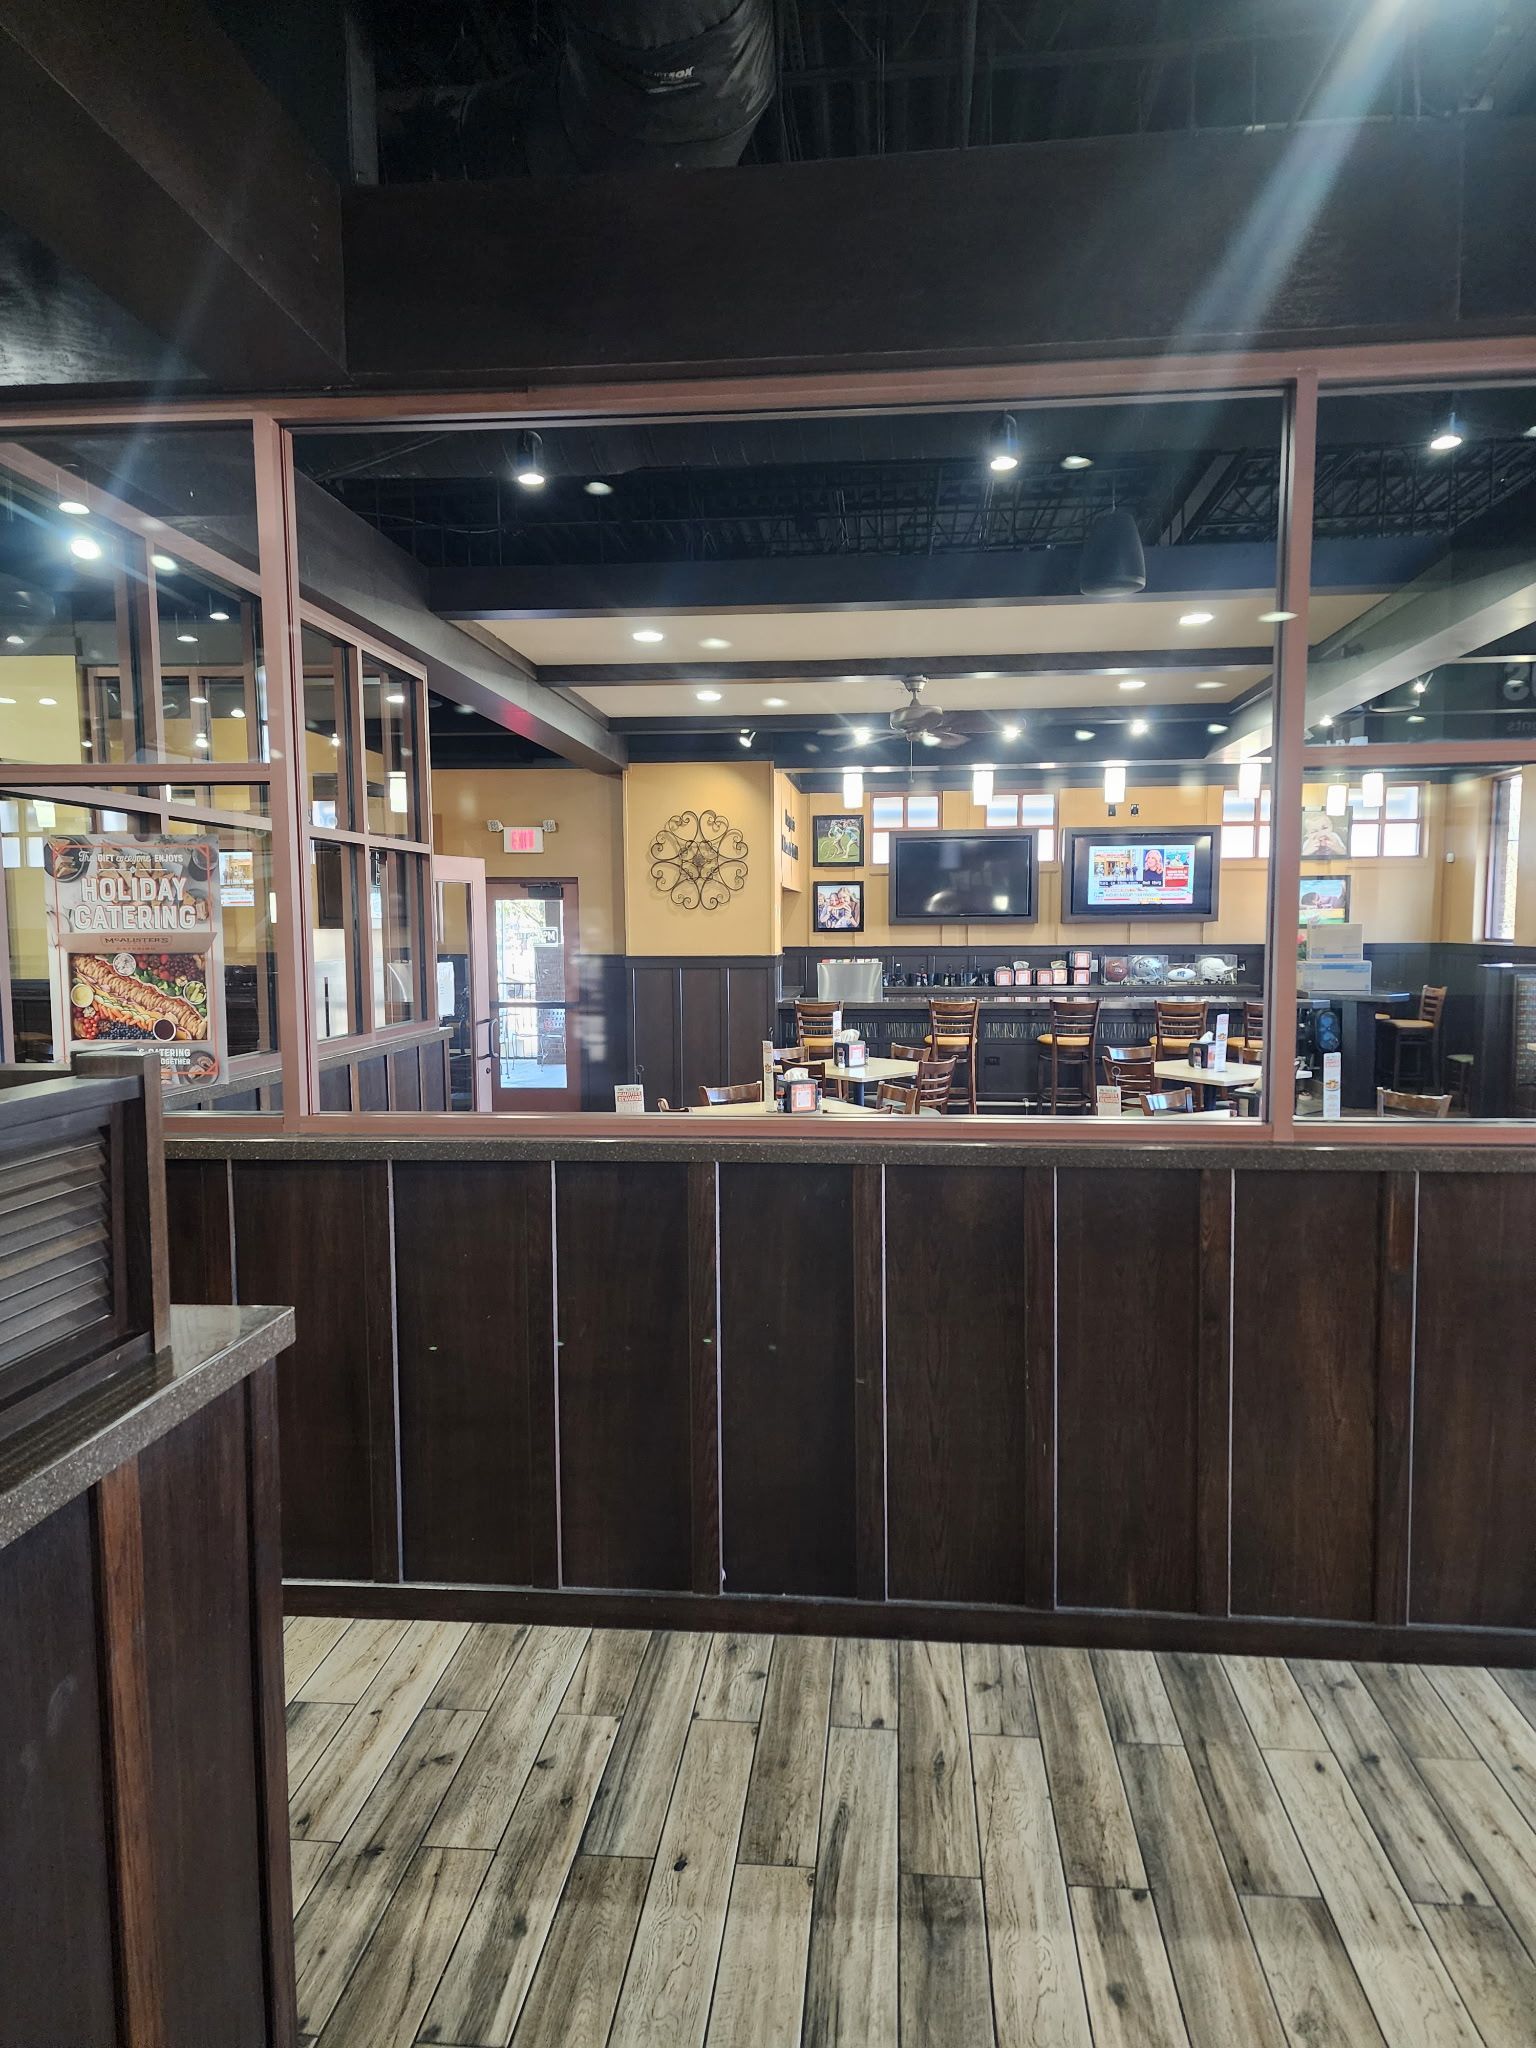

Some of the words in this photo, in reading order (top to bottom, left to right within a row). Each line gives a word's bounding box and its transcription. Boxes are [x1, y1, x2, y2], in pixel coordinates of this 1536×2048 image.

[97, 854, 115, 863] GIFT
[116, 854, 152, 865] everyone
[154, 854, 183, 863] ENJOYS
[81, 877, 187, 902] HOLIDAY
[74, 904, 197, 930] CATERING
